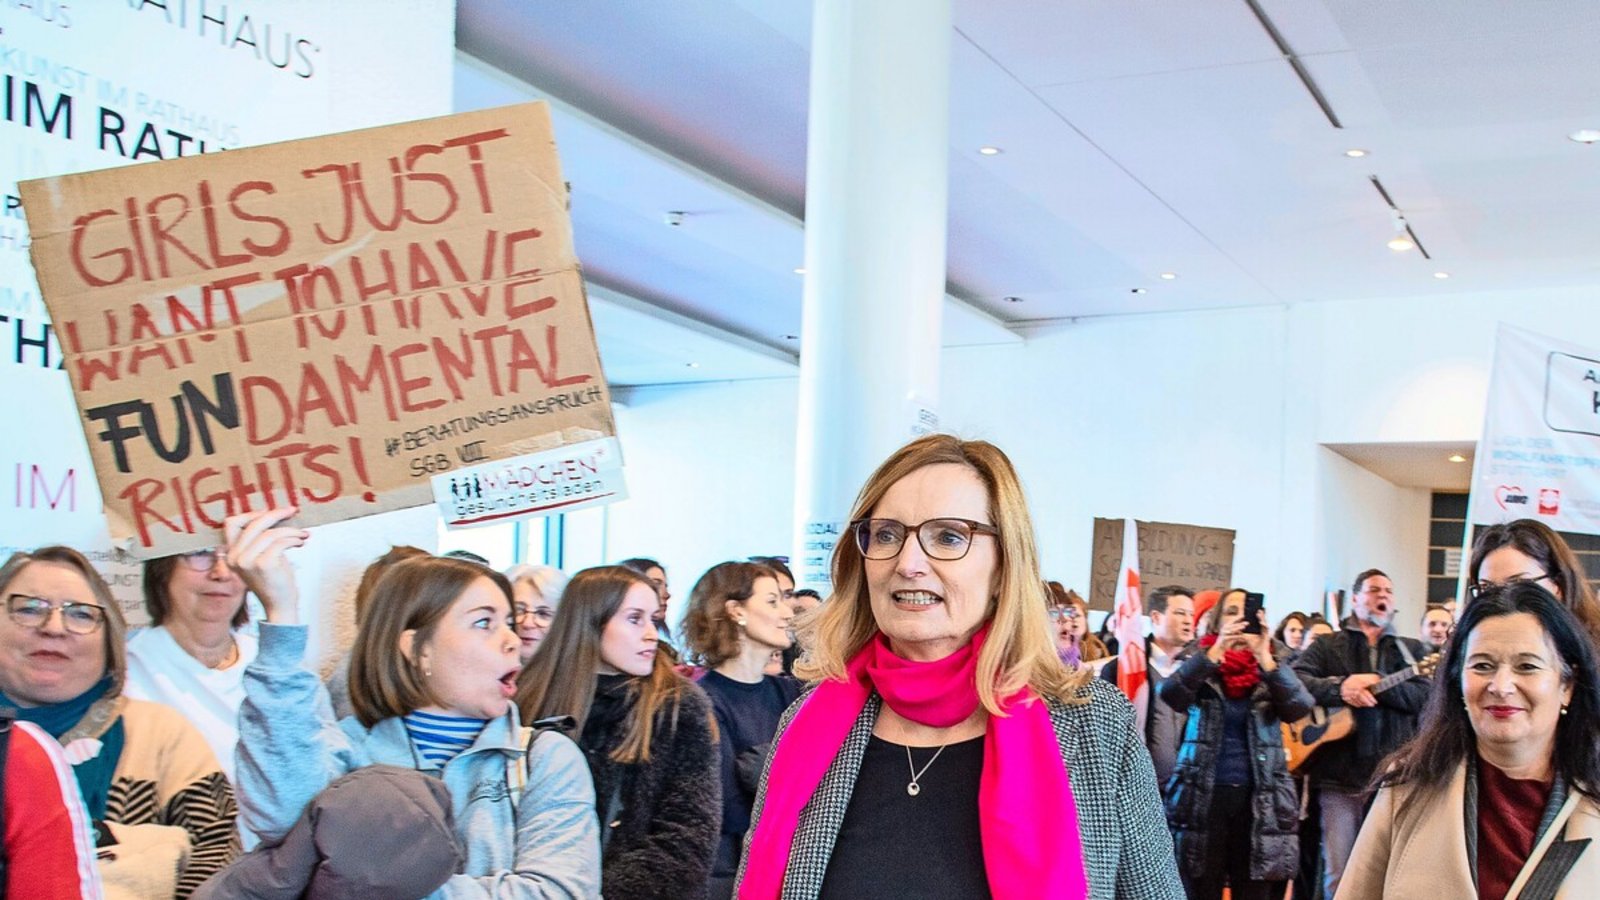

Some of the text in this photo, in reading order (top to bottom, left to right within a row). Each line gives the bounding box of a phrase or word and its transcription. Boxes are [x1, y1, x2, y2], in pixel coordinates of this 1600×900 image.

[4, 74, 73, 140] IM
[70, 128, 511, 288] GIRLS JUST
[63, 227, 558, 391] WANT TO HAVE
[84, 325, 594, 474] FUNDAMENTAL
[384, 384, 603, 458] #BERATUNGSANSPRUCH
[15, 462, 77, 513] IM
[118, 437, 376, 548] RIGHTS!
[409, 453, 452, 477] SGB
